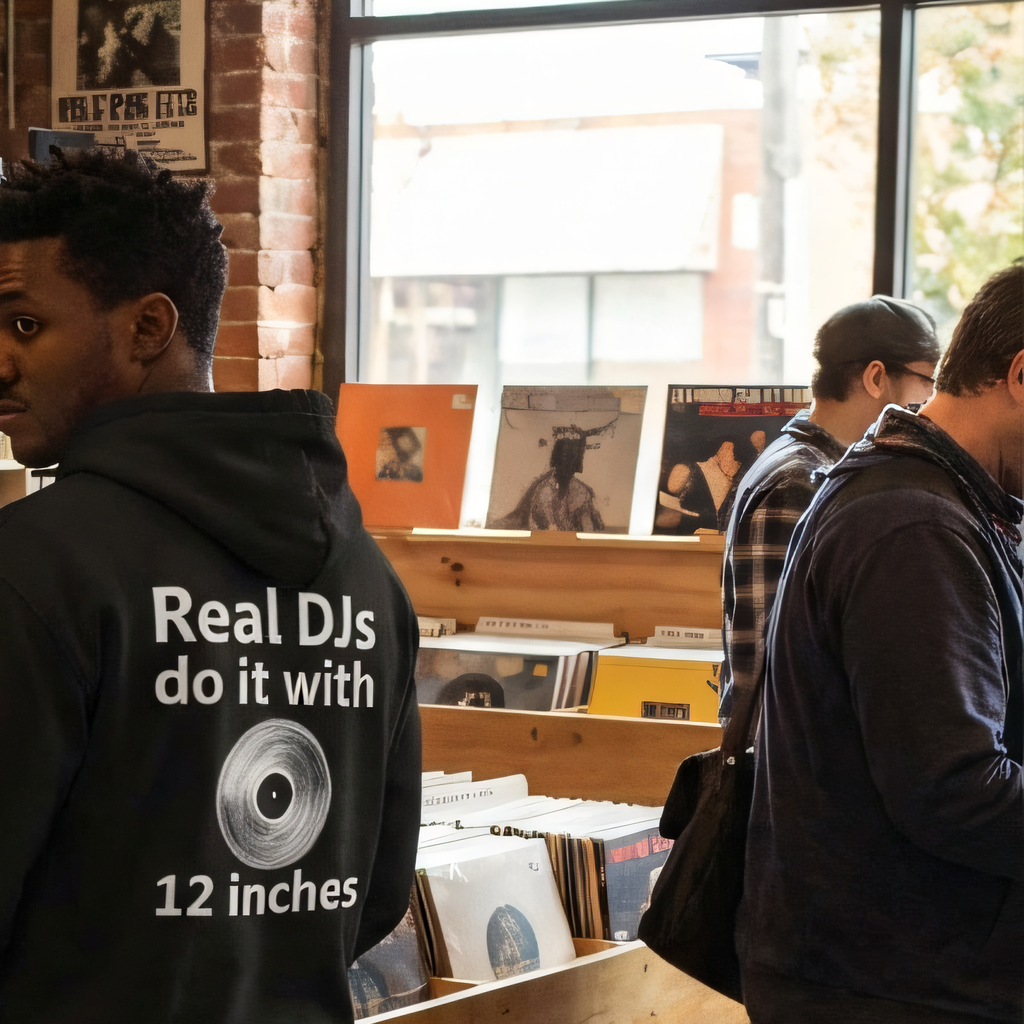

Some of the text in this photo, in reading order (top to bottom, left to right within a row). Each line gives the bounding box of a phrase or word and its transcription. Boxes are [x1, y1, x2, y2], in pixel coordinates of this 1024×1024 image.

[152, 585, 376, 651] Real DJs
[154, 654, 374, 709] do it with
[155, 868, 359, 917] 12 inches
